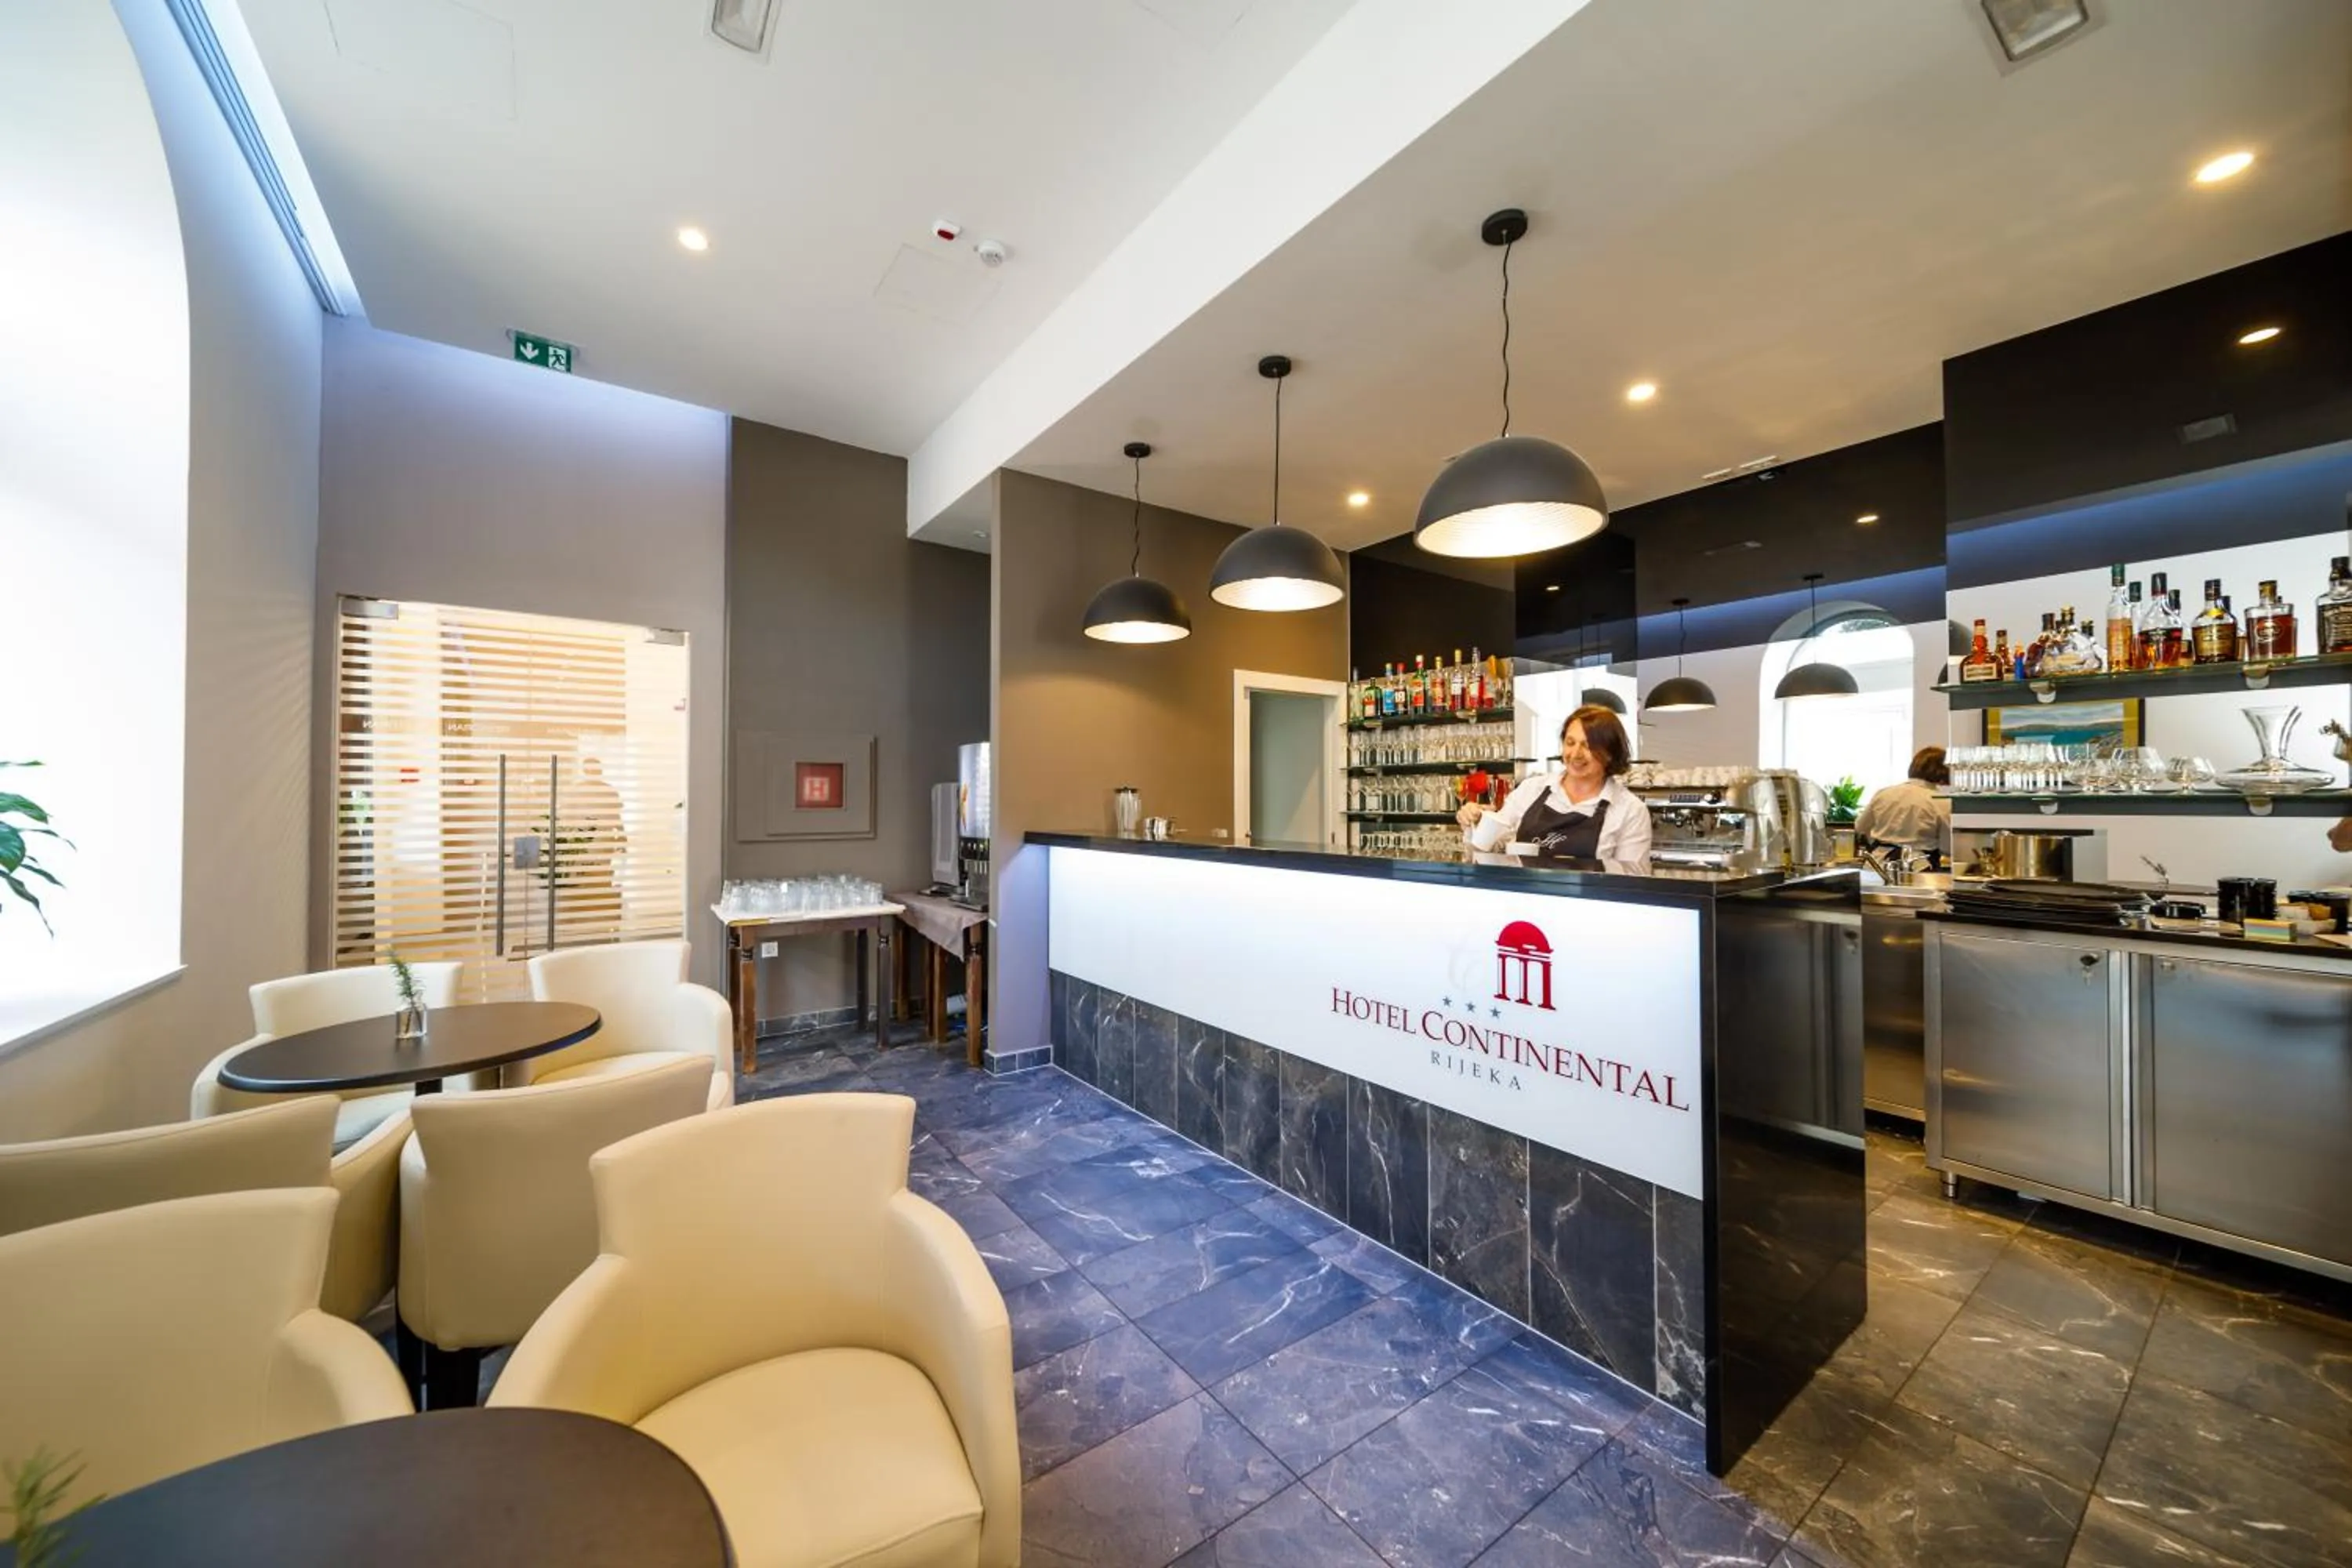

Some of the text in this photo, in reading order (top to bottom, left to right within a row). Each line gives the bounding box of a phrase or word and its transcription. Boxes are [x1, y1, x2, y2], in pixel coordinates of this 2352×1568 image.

[1331, 987, 1690, 1112] HOTEL CONTINENTAL
[1430, 1050, 1522, 1091] RIJEKA
